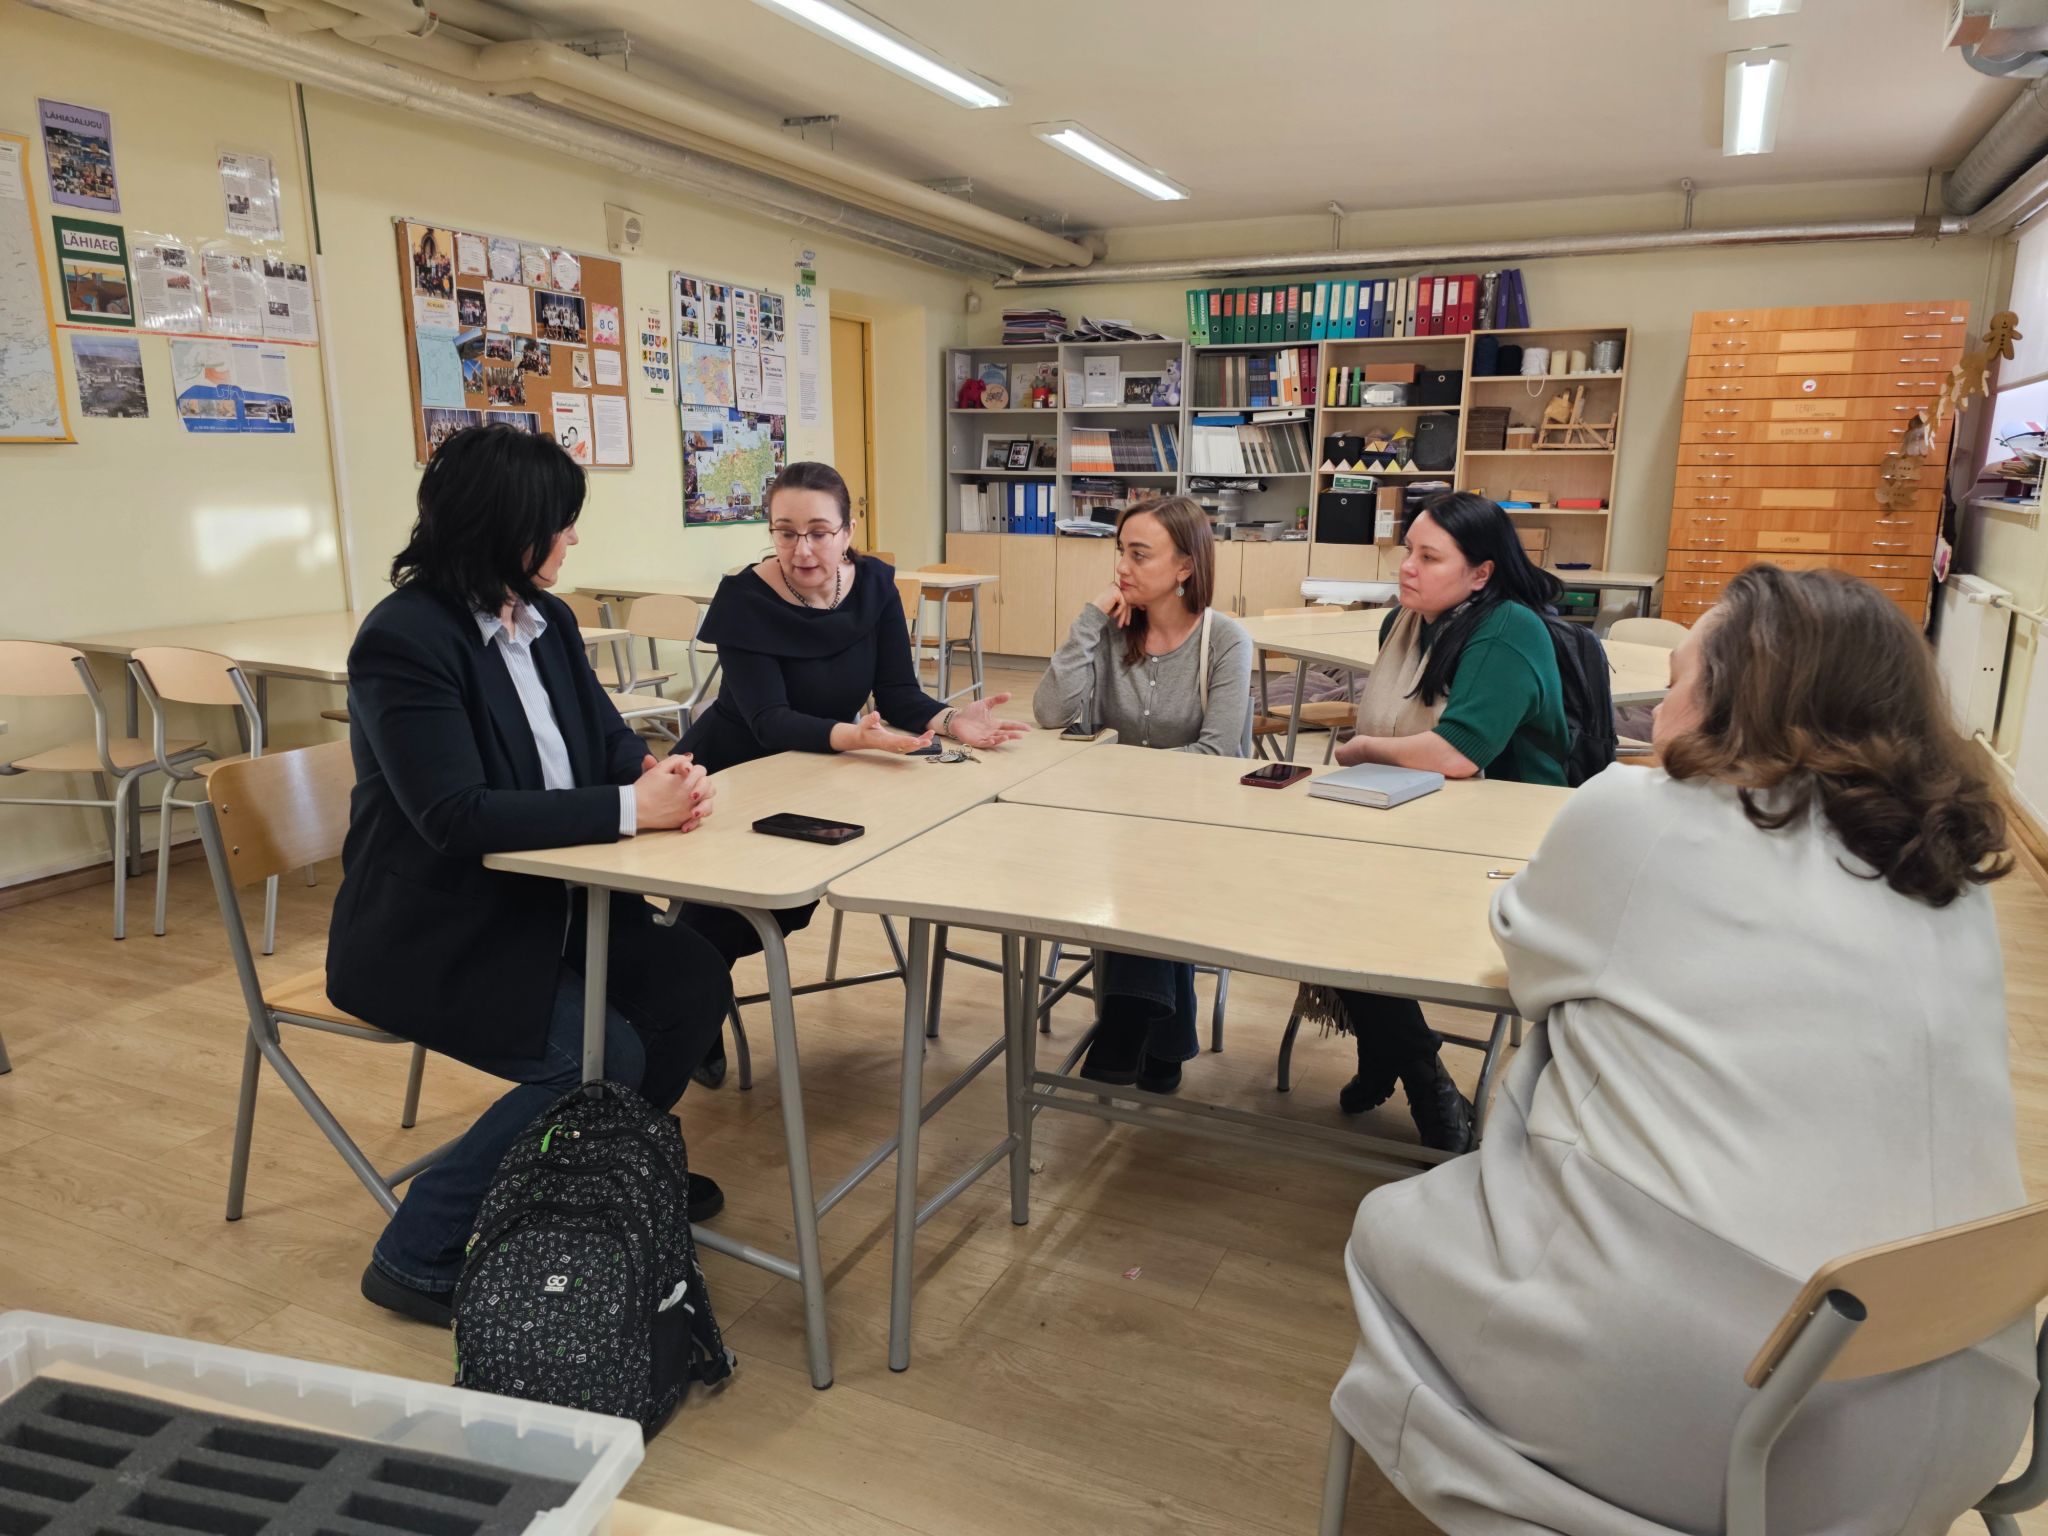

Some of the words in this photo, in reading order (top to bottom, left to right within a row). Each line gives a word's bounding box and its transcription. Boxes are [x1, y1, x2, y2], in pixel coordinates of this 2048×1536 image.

[45, 111, 102, 129] LÄHIAJALUGU
[63, 232, 118, 252] LÄHIAEG
[795, 284, 811, 300] Bolt
[599, 319, 605, 330] 8
[607, 320, 614, 331] C
[547, 1275, 567, 1286] GO
